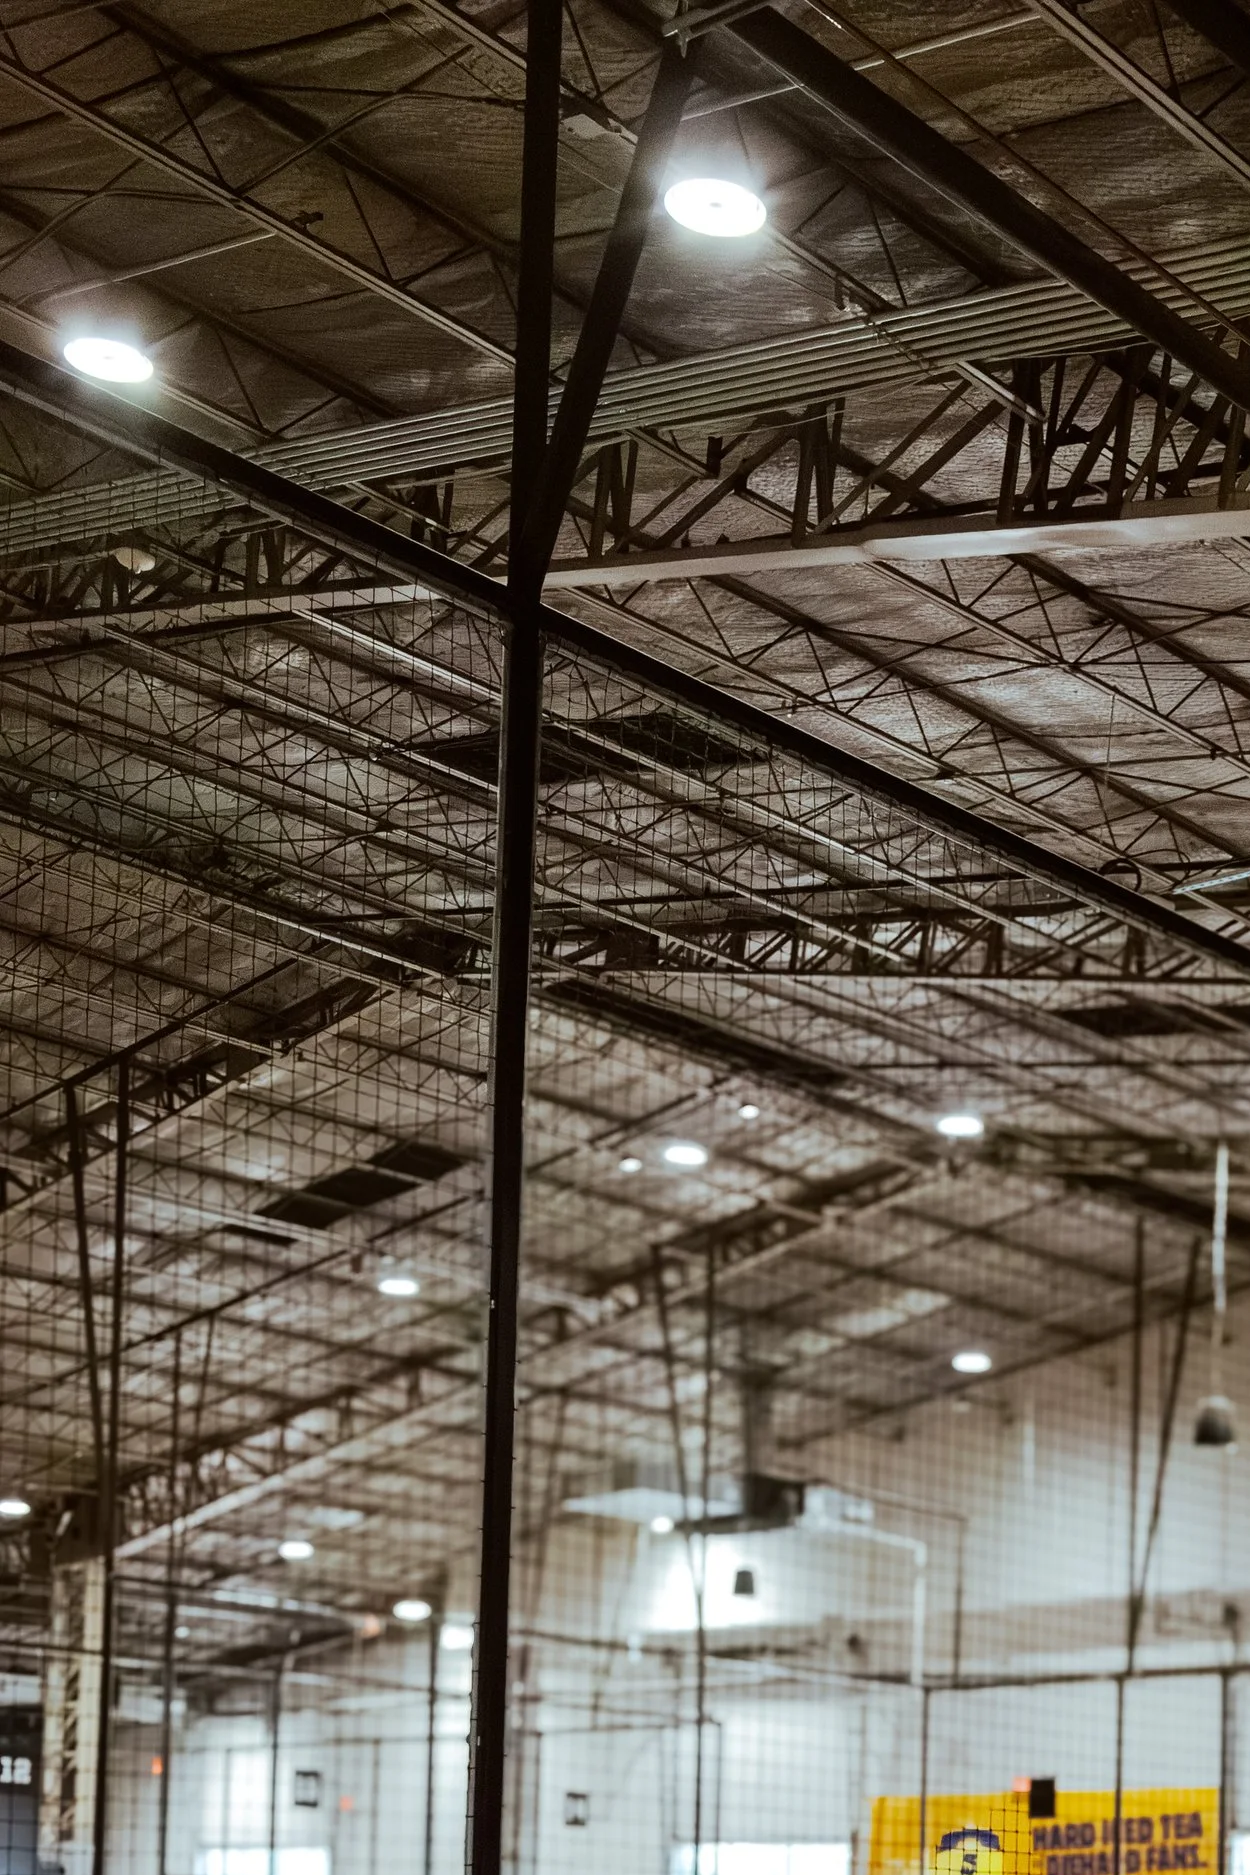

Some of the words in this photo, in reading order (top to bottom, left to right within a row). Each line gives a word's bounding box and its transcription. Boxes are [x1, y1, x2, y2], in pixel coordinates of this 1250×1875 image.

[0, 1756, 32, 1785] 12
[1033, 1823, 1095, 1850] HARD
[1160, 1812, 1203, 1839] TEA
[1147, 1844, 1207, 1871] FANS.
